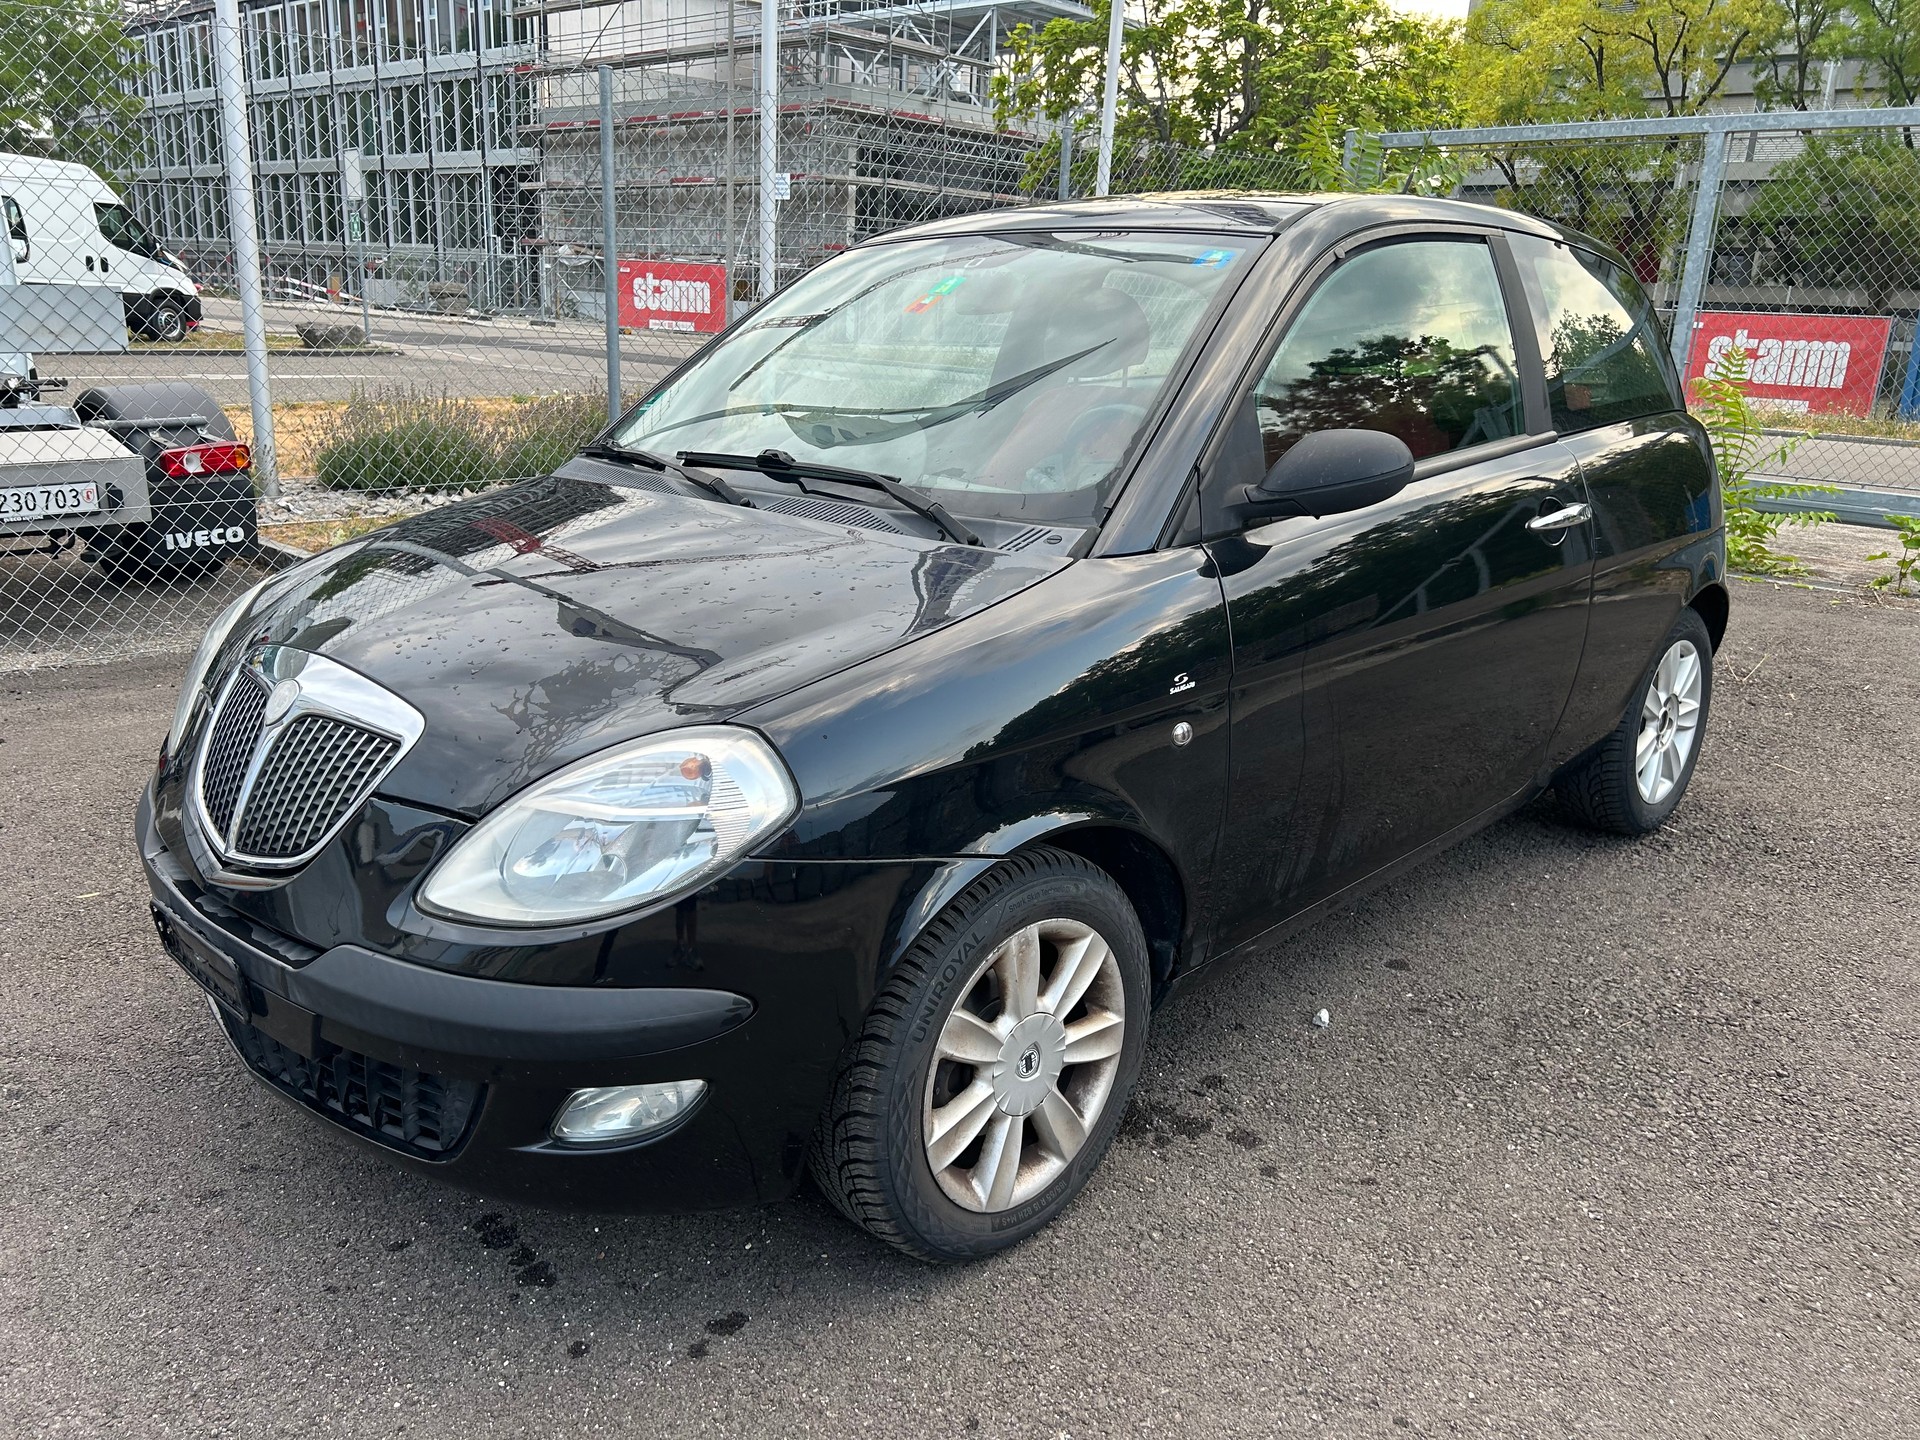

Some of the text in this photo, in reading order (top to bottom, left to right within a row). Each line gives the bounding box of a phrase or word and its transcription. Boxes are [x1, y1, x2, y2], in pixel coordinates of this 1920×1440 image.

[633, 272, 711, 314] stamm
[1703, 329, 1851, 389] stamm
[0, 488, 81, 514] 230703
[165, 526, 245, 550] IVECO
[912, 932, 986, 1043] UNIROYAL
[1033, 1201, 1041, 1211] 15
[1041, 1198, 1047, 1206] R
